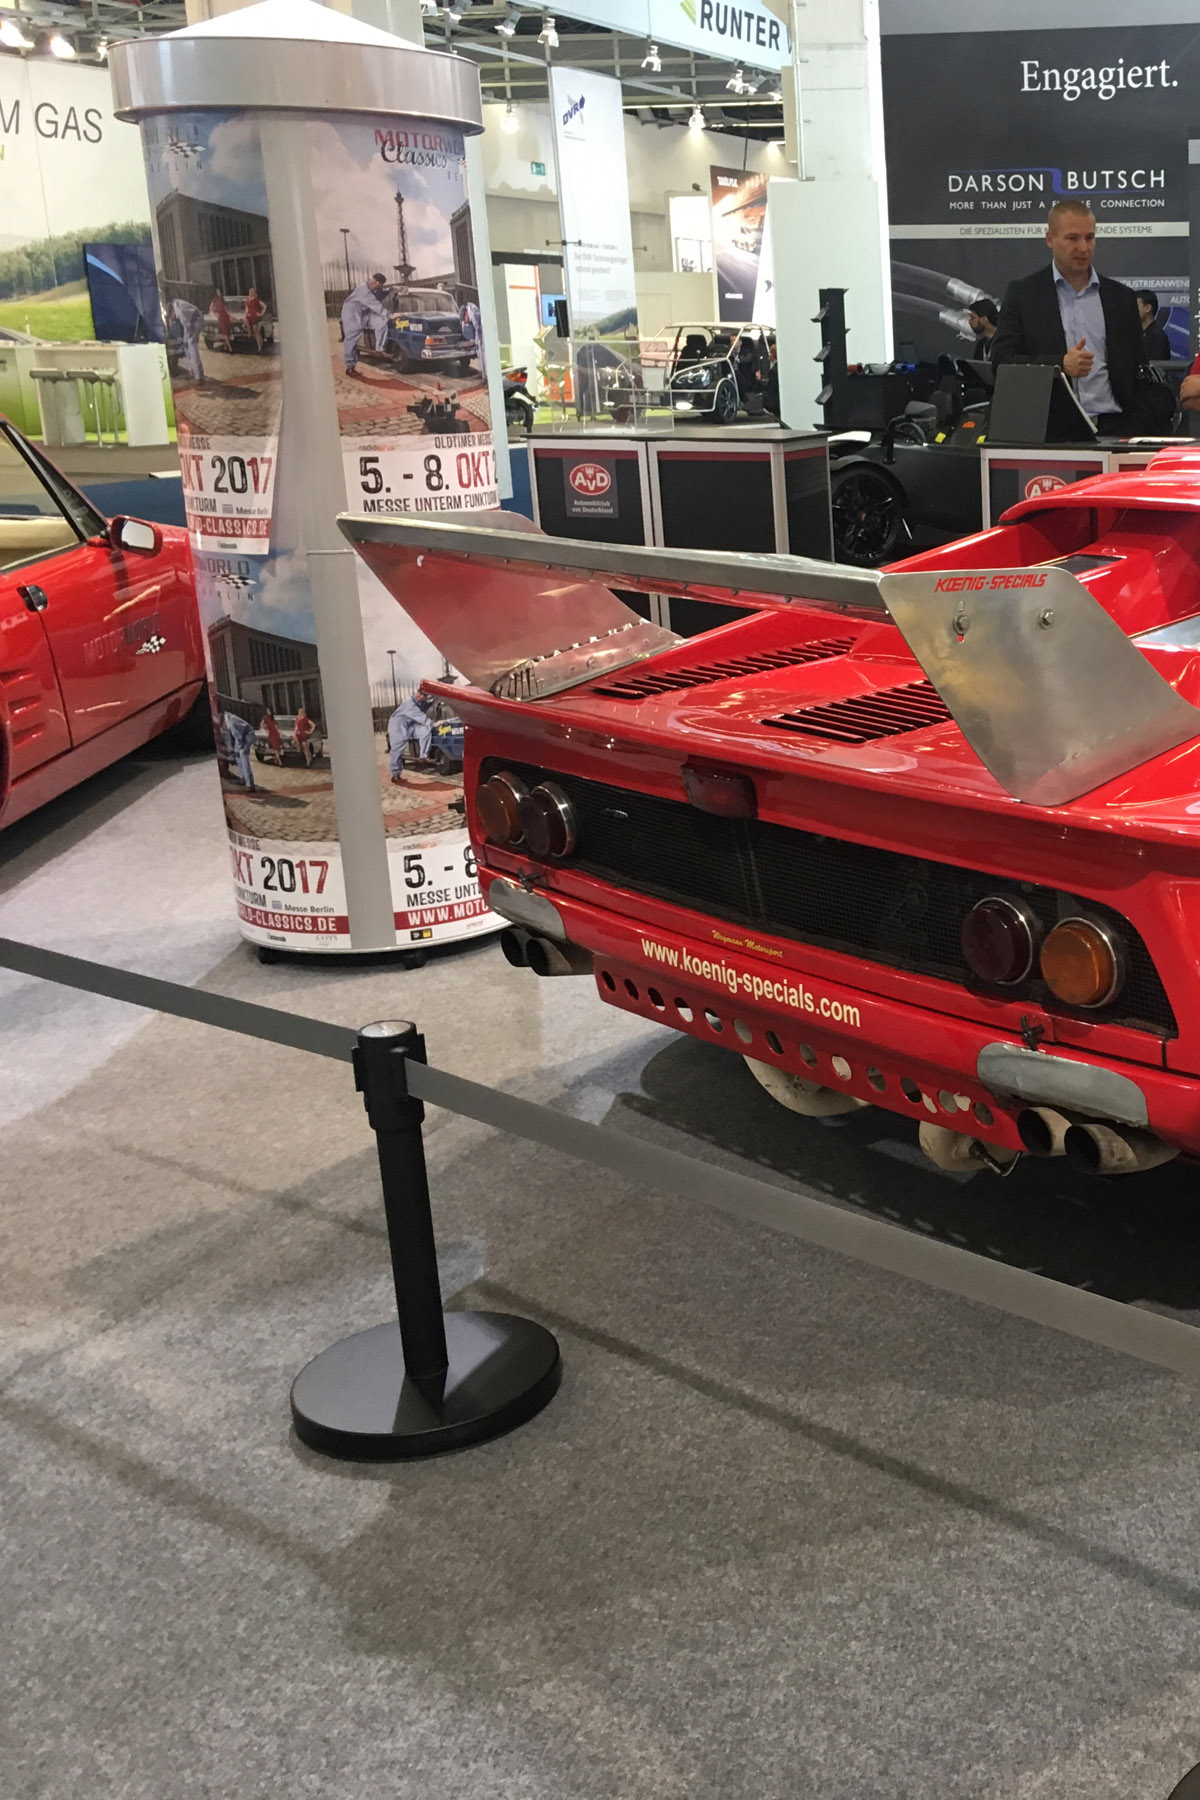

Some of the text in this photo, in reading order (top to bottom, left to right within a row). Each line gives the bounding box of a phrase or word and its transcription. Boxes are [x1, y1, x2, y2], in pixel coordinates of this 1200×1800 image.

[700, 0, 780, 51] RUNTER
[1020, 58, 1178, 101] Engagiert.
[35, 102, 103, 144] GAS
[948, 169, 1165, 193] DARSON BUTSCH
[949, 201, 975, 211] MORE
[981, 201, 1008, 210] THAN
[1012, 200, 1032, 211] JUST
[1038, 200, 1046, 209] A
[1100, 199, 1165, 209] CONNECTION
[960, 227, 972, 235] DIE
[974, 226, 1025, 236] SPEZIALISTEN
[1027, 224, 1043, 235] FÜR
[1119, 225, 1153, 235] SYSTEME
[434, 434, 476, 449] OLDTIMER
[210, 454, 273, 495] 2017
[359, 456, 391, 494] 5.
[423, 454, 449, 492] 8.
[456, 450, 491, 489] OKT
[363, 498, 411, 513] MESSE
[415, 494, 463, 512] UNTERM
[260, 855, 329, 894] 2017
[403, 853, 434, 888] 5.
[284, 903, 308, 913] Messe
[310, 904, 335, 914] Berlin
[406, 888, 452, 907] MESSE
[641, 938, 861, 1028] www.koenig-specials.com
